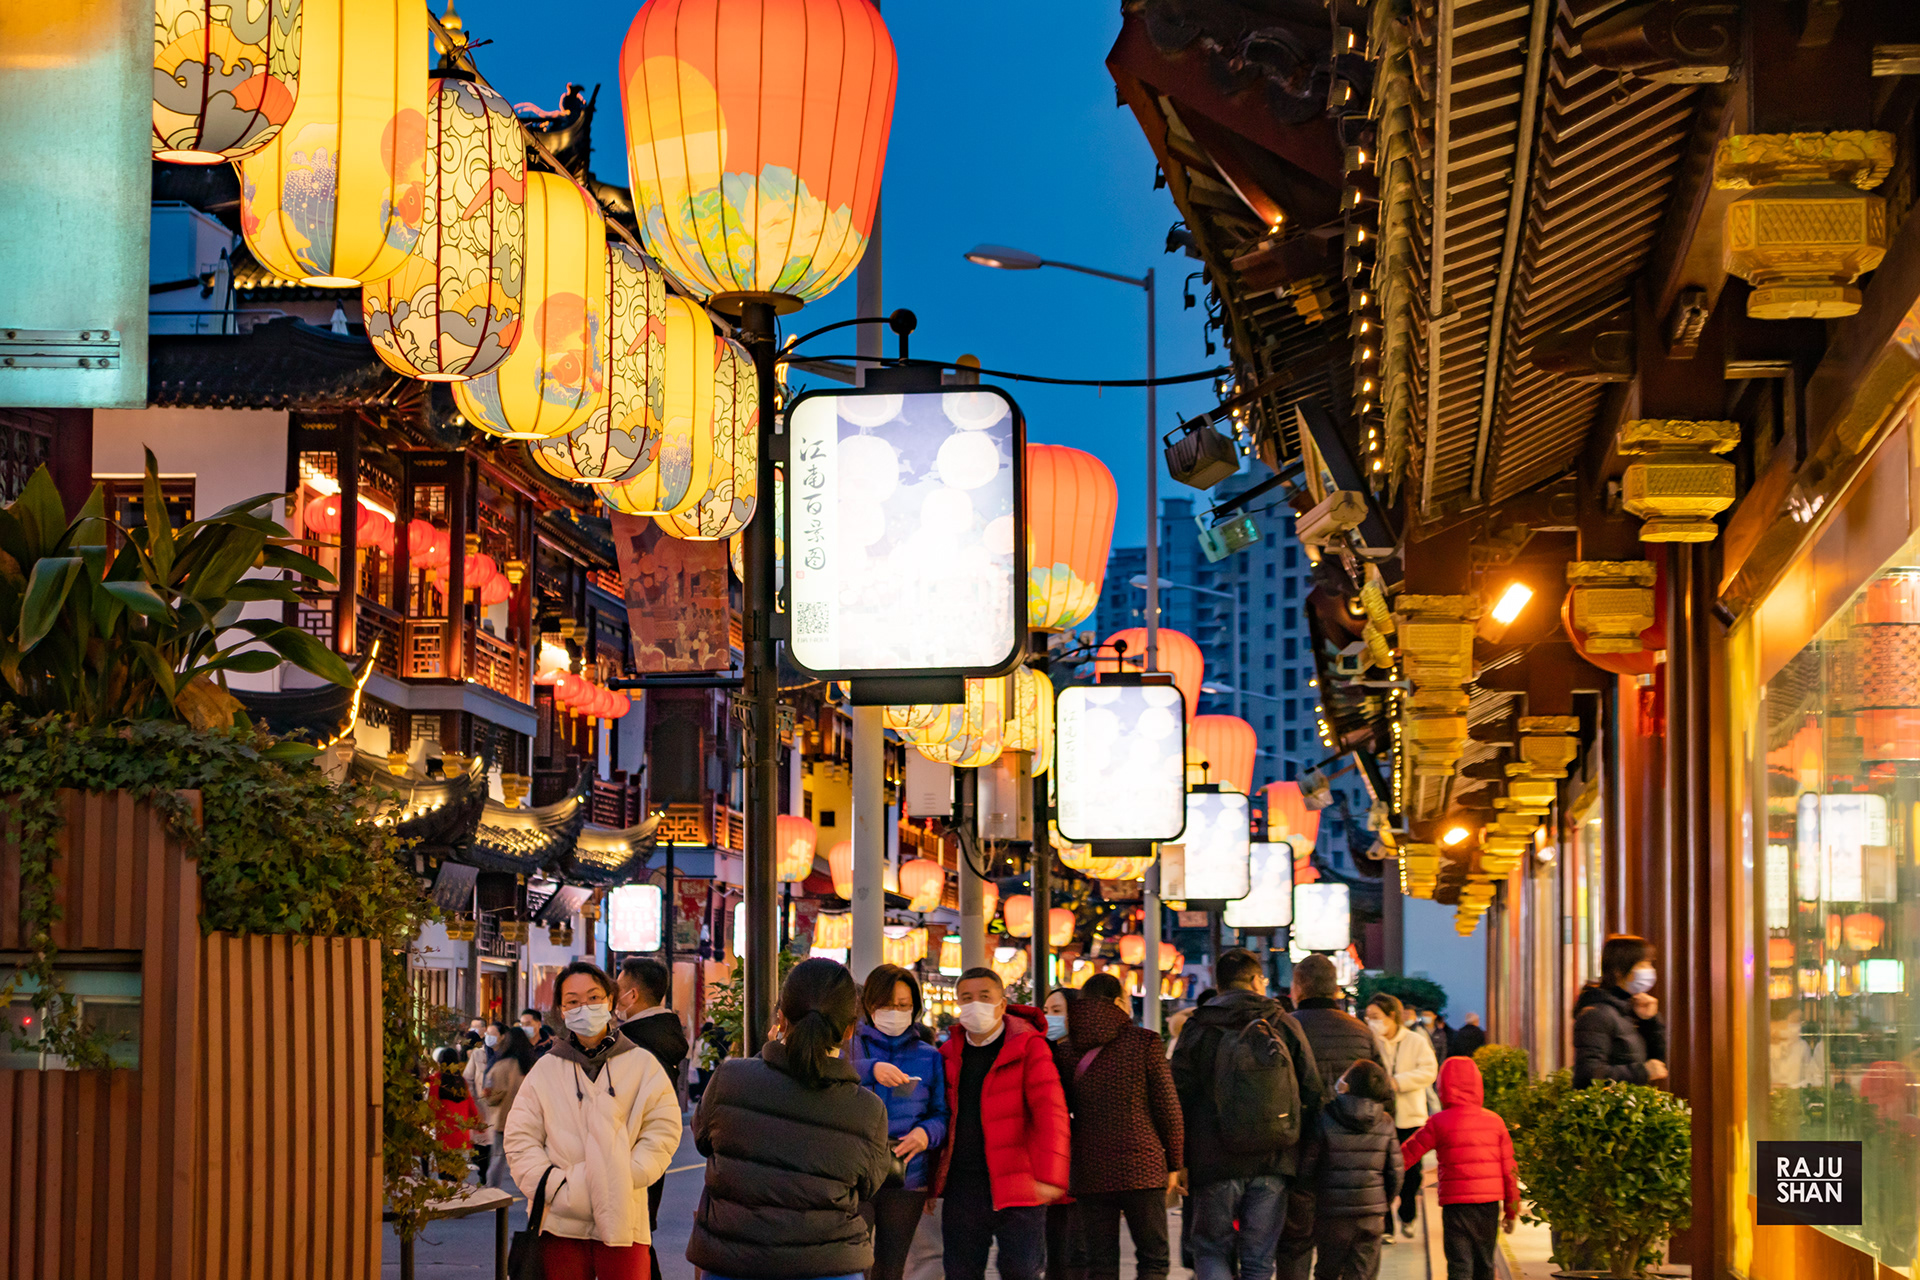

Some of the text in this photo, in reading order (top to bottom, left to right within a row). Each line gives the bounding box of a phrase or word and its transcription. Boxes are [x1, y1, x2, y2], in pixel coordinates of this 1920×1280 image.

[799, 437, 827, 571] 江南百景图
